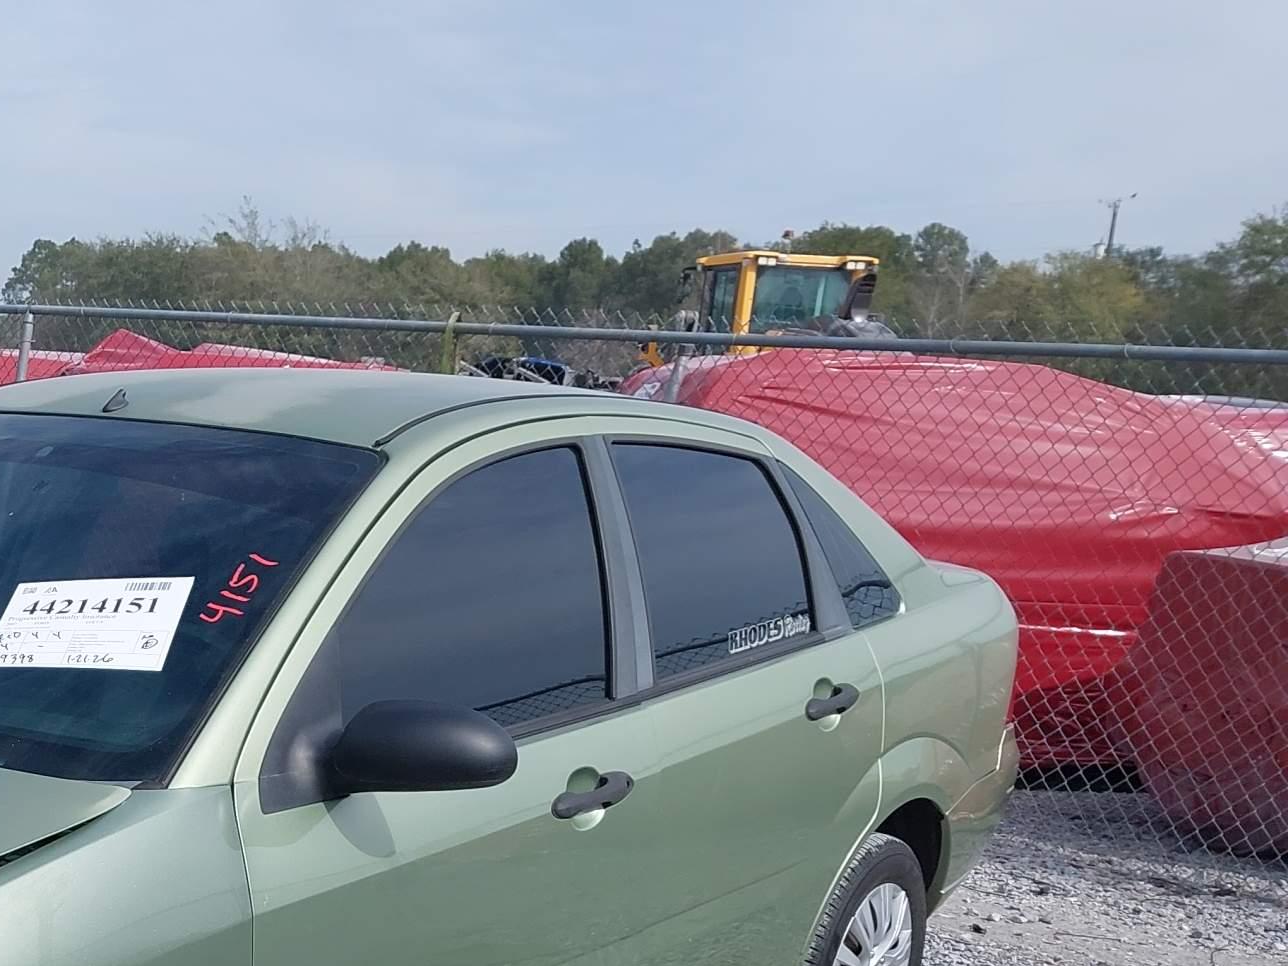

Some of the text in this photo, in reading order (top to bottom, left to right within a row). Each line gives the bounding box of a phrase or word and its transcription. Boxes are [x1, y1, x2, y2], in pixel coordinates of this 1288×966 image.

[22, 597, 159, 615] 44214151
[199, 553, 279, 623] 4151
[728, 617, 784, 654] RHODES
